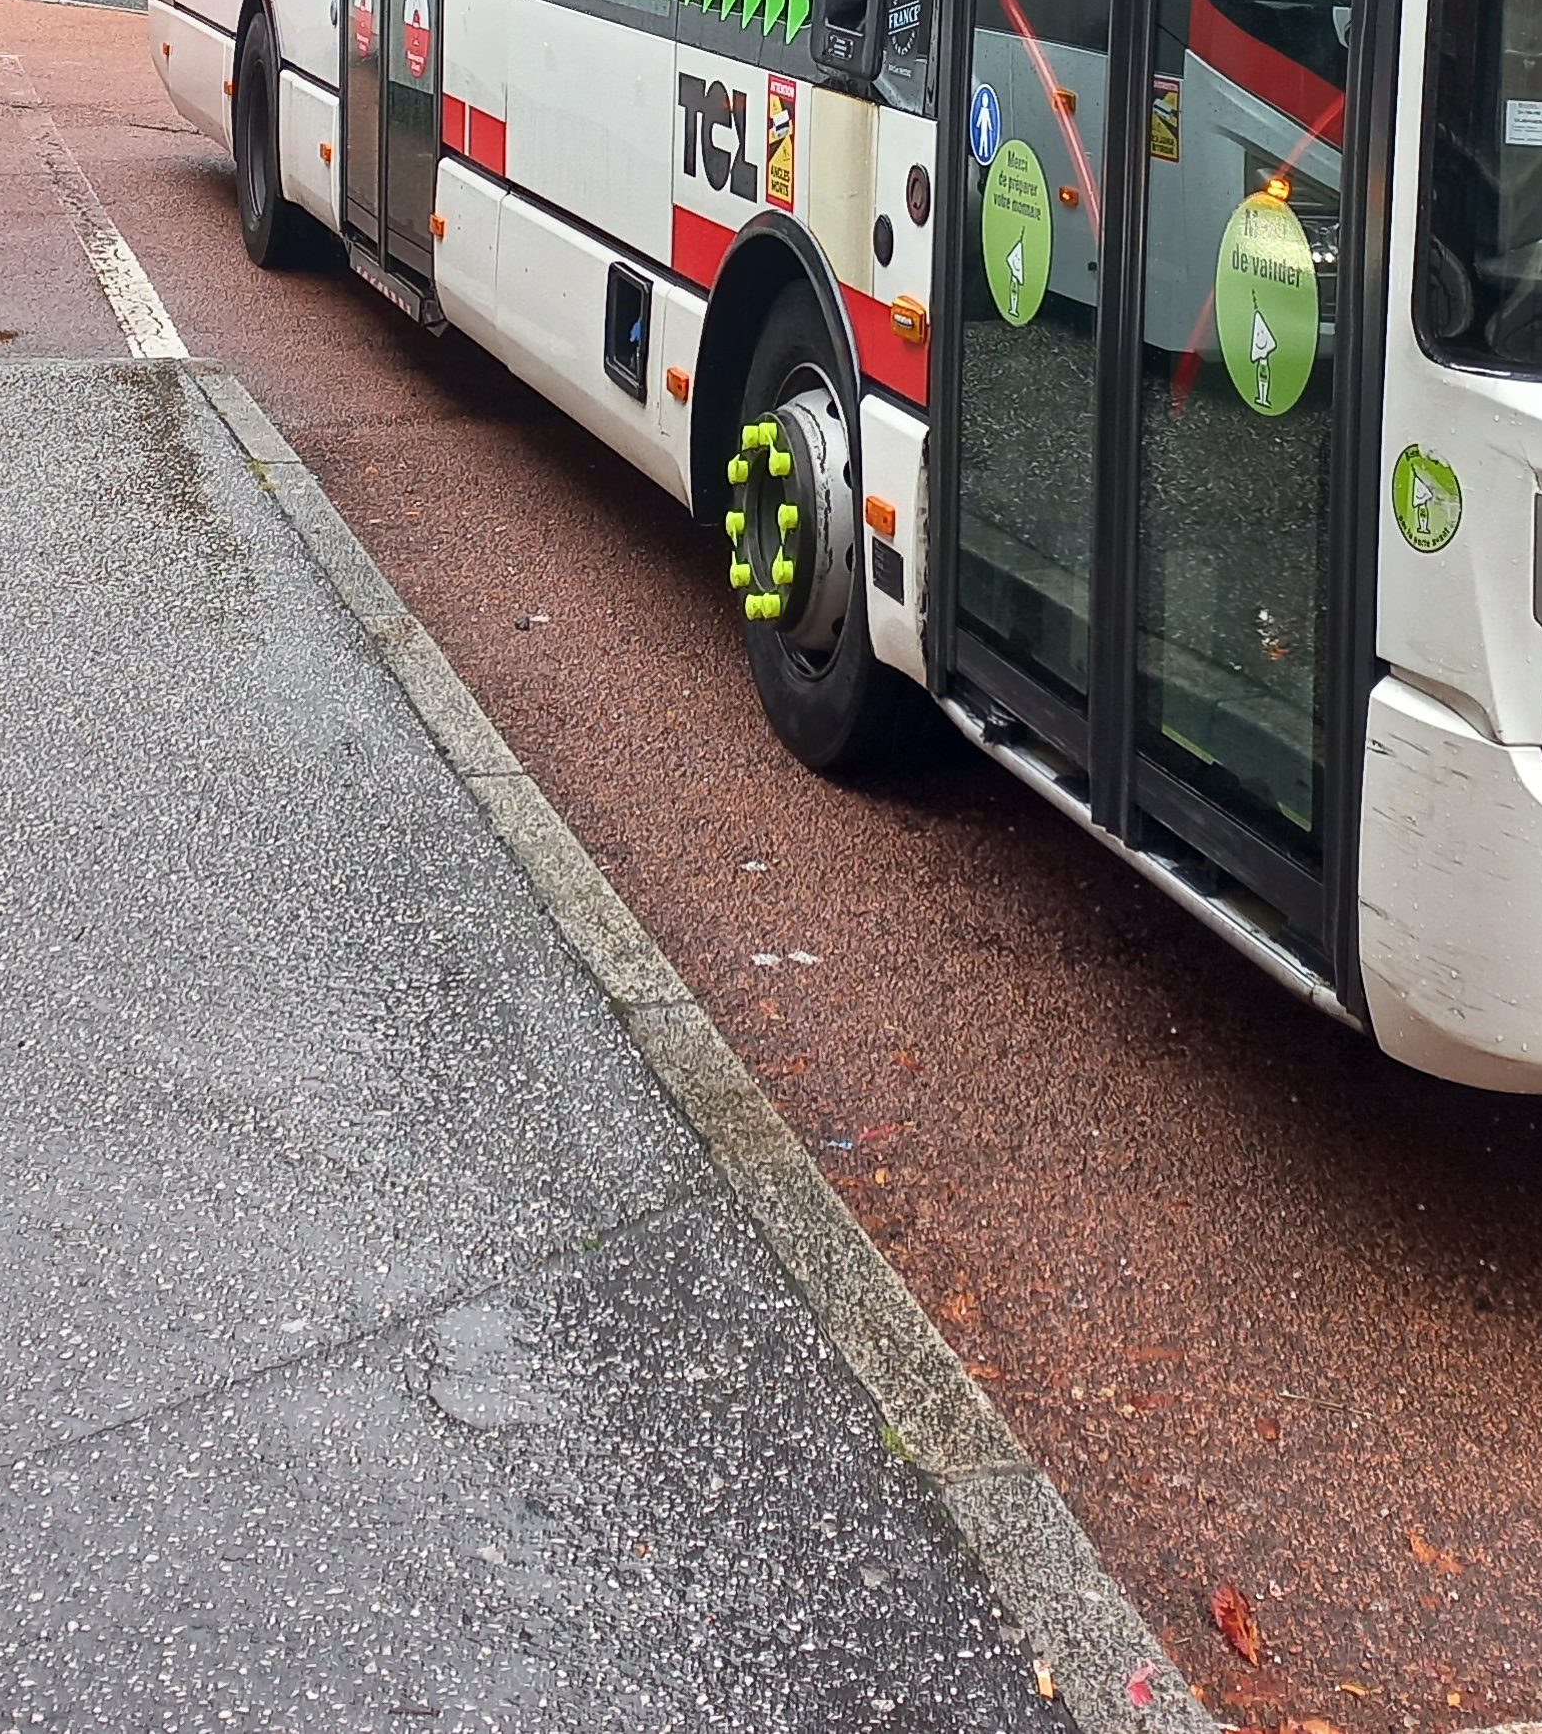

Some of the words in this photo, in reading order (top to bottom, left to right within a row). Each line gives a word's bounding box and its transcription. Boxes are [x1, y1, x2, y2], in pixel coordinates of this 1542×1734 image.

[678, 71, 758, 204] TCL
[770, 163, 791, 183] ANGLES
[1007, 150, 1028, 172] Merci
[1232, 247, 1248, 273] de
